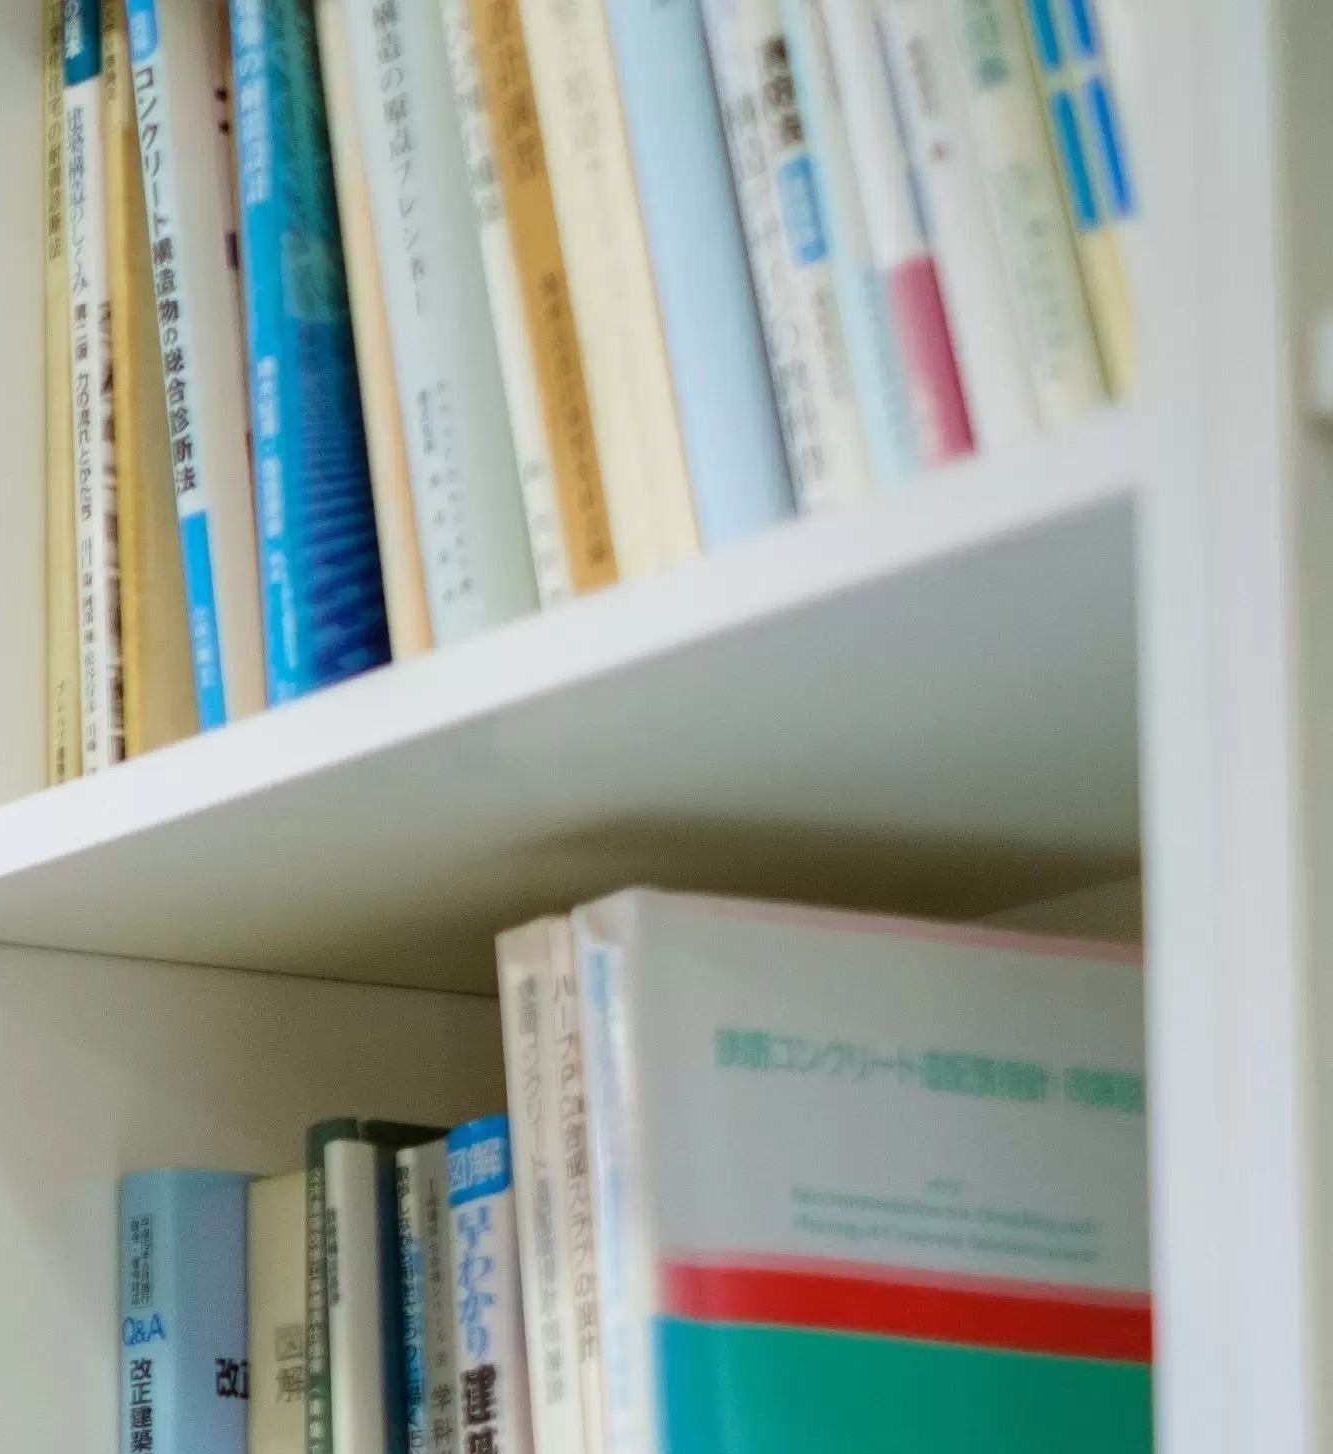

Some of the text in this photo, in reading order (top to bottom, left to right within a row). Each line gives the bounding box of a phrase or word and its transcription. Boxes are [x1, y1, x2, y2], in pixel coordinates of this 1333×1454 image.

[134, 65, 198, 494] コンクリート構造物の総合診断法
[122, 1313, 166, 1346] Q&A
[456, 1205, 496, 1360] 早わかり
